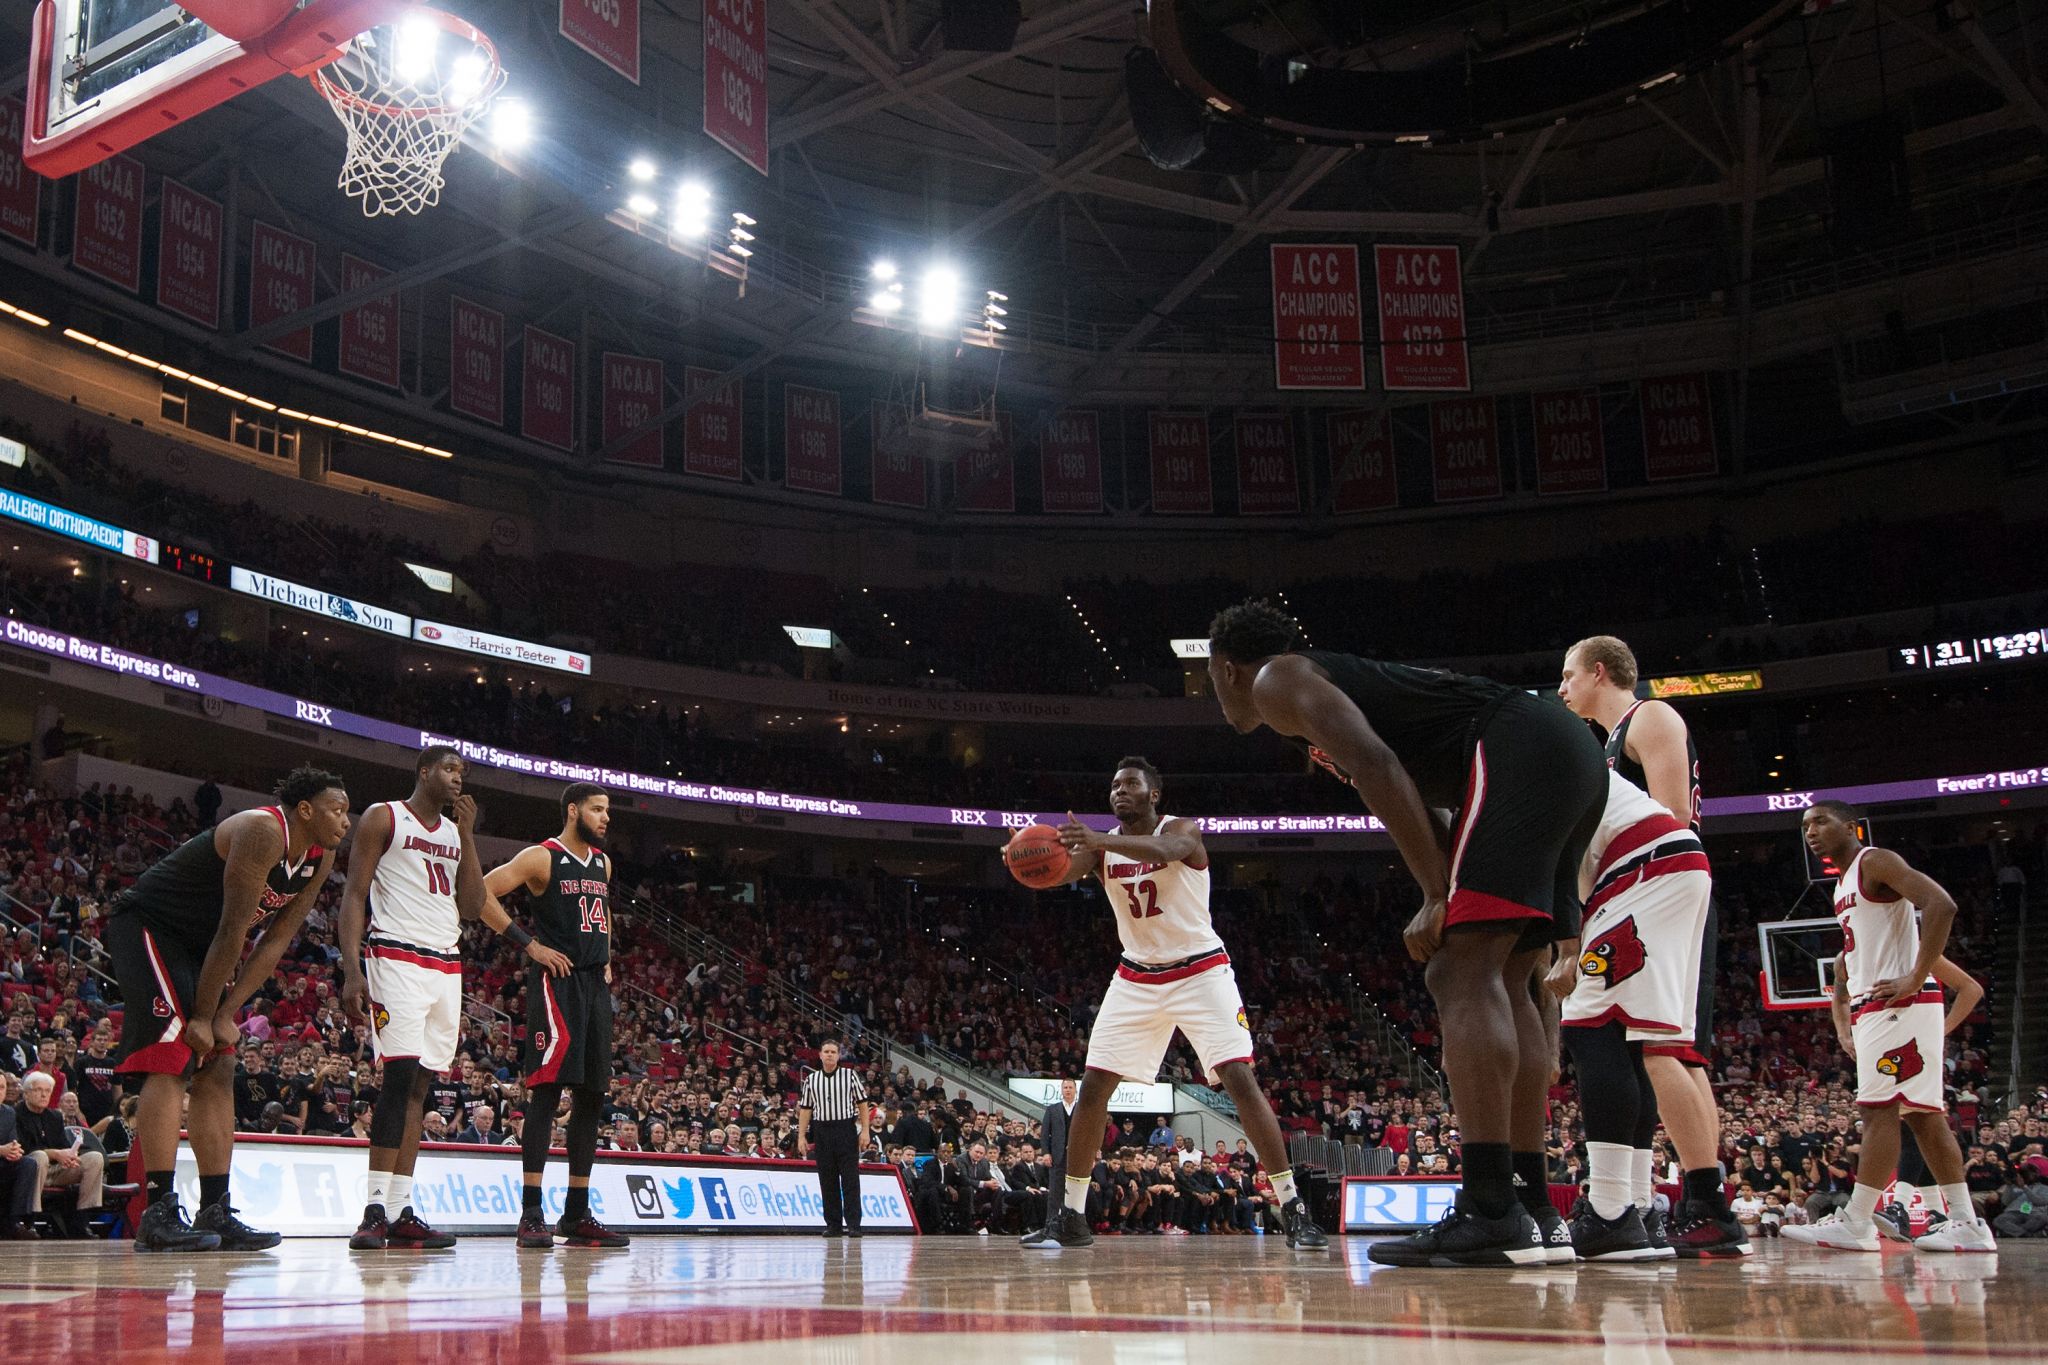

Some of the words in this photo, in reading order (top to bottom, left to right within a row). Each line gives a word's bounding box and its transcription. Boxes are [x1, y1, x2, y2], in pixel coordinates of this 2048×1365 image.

[707, 14, 764, 84] CHAMPIONS
[721, 65, 752, 128] 1983
[88, 158, 136, 201] NCAA
[94, 200, 127, 242] 1952
[170, 194, 214, 242] NCAA
[176, 239, 205, 280] 1954
[261, 235, 307, 280] NCAA
[1291, 252, 1340, 285] ACC
[1395, 253, 1442, 286] ACC
[267, 277, 298, 314] 1956
[1279, 291, 1356, 318] CHAMPIONS
[1384, 292, 1458, 318] CHAMPIONS
[356, 306, 387, 344] 1965
[457, 308, 496, 348] NCAA
[1298, 323, 1340, 356] 1974
[1403, 324, 1444, 357] 1973
[464, 348, 491, 382] 1970
[531, 339, 567, 376] NCAA
[611, 364, 655, 395] NCAA
[793, 394, 833, 424] NCAA
[1648, 381, 1701, 411] NCAA
[1438, 405, 1488, 433] NCAA
[1543, 399, 1592, 425] NCAA
[700, 413, 728, 442] 1985
[1047, 421, 1090, 444] NCAA
[1158, 422, 1201, 447] NCAA
[1242, 424, 1287, 449] NCAA
[1657, 415, 1701, 446] 2006
[800, 430, 827, 459] 1986
[1446, 438, 1489, 469] 2004
[1551, 431, 1593, 463] 2005
[1057, 452, 1086, 480] 1989
[1165, 456, 1196, 482] 1991
[1249, 456, 1287, 483] 2002
[0, 491, 46, 525] RALEIGH
[49, 508, 122, 549] ORTHOPAEDIC
[249, 574, 323, 612] Michael
[361, 607, 393, 632] Son
[7, 620, 66, 654] Choose
[69, 637, 99, 662] Rex
[100, 646, 161, 679] Express
[162, 663, 201, 690] Care.
[470, 635, 512, 657] Harris
[515, 645, 556, 666] Teeter
[1185, 643, 1205, 652] REX
[1900, 648, 1918, 657] TOL
[1936, 641, 1964, 659] 31
[1980, 631, 2041, 654] 19:29
[1997, 649, 2024, 660] 2ND
[1905, 655, 1915, 665] 3
[1934, 657, 1949, 667] NC
[1949, 655, 1972, 666] STATE
[1718, 682, 1746, 690] DEW
[1727, 674, 1752, 683] THE
[295, 700, 333, 726] REX
[828, 689, 873, 706] Home
[877, 695, 893, 707] of
[898, 696, 921, 709] the
[926, 698, 950, 710] NC
[952, 700, 994, 714] State
[997, 701, 1072, 717] Wolfpack
[462, 741, 488, 763] Flu?
[488, 748, 532, 774] Sprains
[533, 760, 548, 773] or
[549, 760, 600, 784] Strains?
[601, 770, 628, 787] Feel
[629, 774, 666, 794] Better
[667, 781, 708, 799] Faster.
[709, 787, 755, 804] Choose
[756, 791, 779, 806] Rex
[780, 794, 829, 813] Express
[830, 799, 862, 817] Care.
[1936, 774, 1996, 793] Fever?
[1998, 768, 2038, 788] Flu?
[1767, 792, 1814, 810] REX
[950, 809, 988, 826] REX
[1000, 812, 1038, 828] REX
[1207, 816, 1259, 834] Sprains
[1261, 821, 1276, 830] or
[1278, 816, 1334, 830] Strains?
[1336, 816, 1366, 829] Feel
[422, 857, 451, 896] 10
[560, 880, 580, 895] NC
[581, 879, 608, 897] STATE
[1121, 879, 1164, 919] 32
[578, 896, 609, 934] 14
[95, 1067, 114, 1076] STATE
[1110, 1087, 1145, 1104] Direct
[1347, 1185, 1458, 1224] RE
